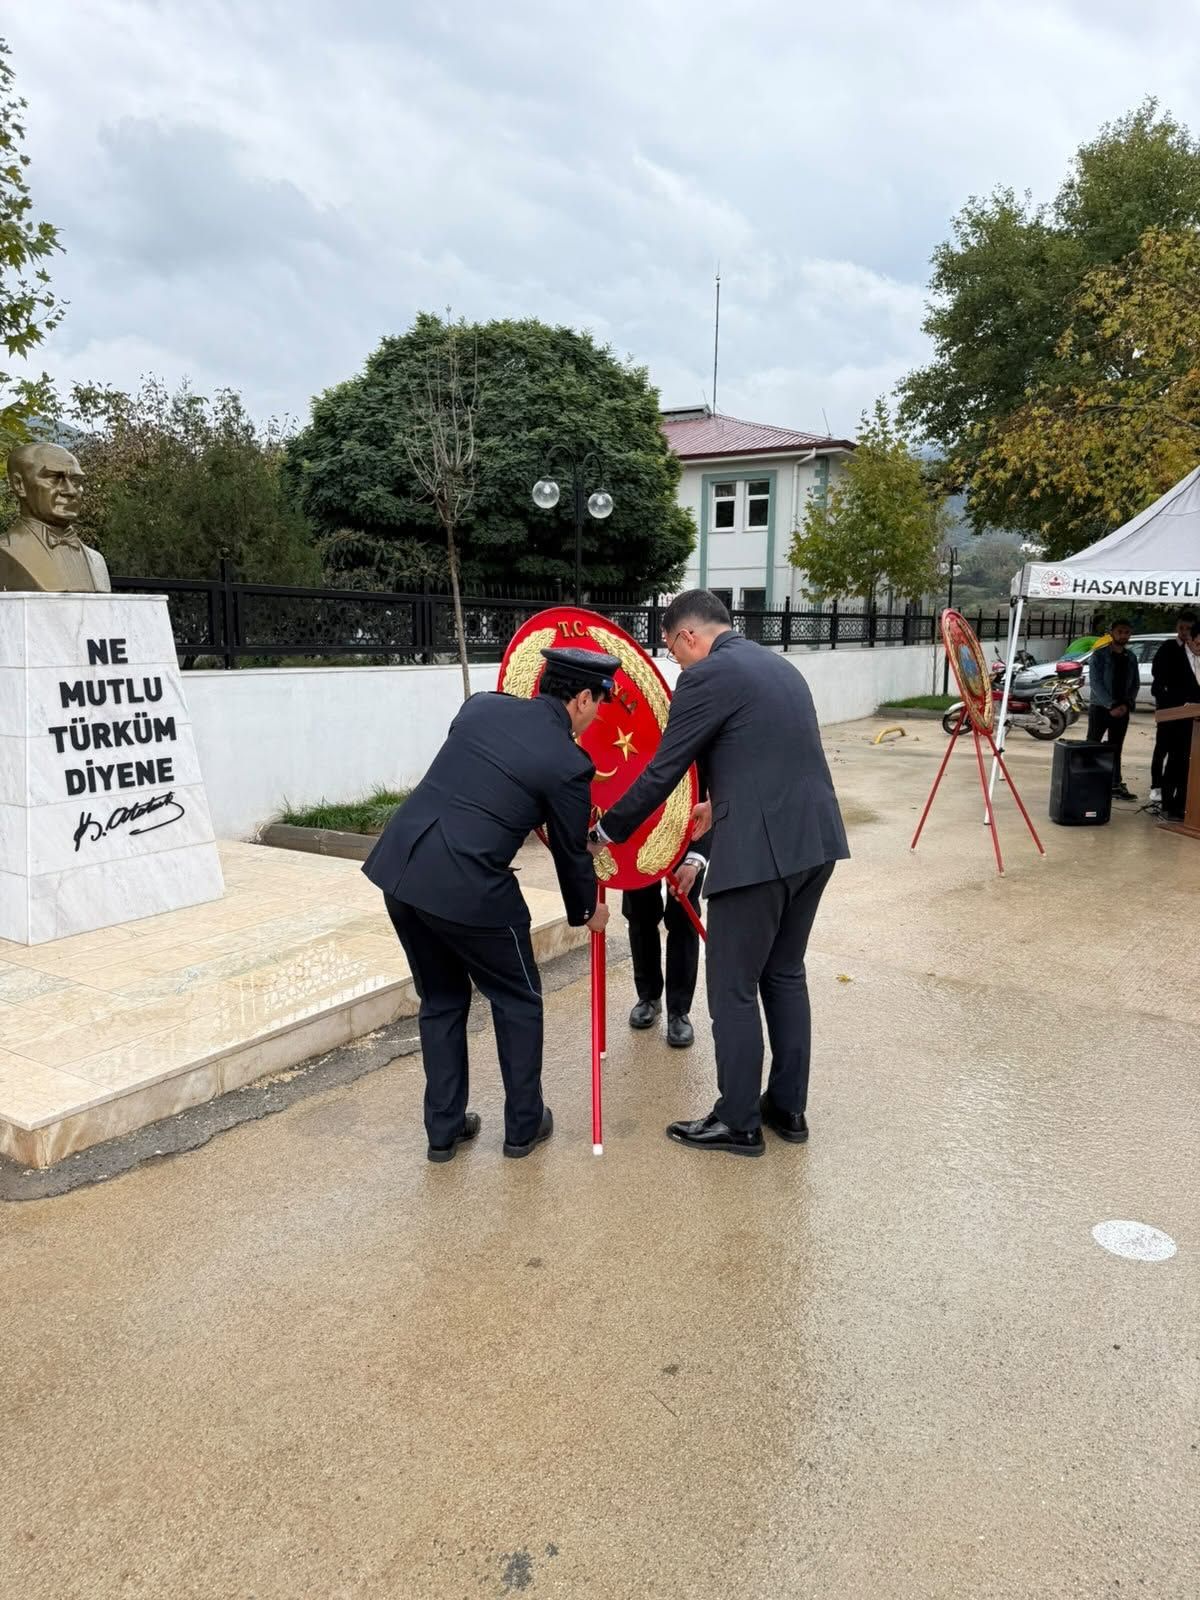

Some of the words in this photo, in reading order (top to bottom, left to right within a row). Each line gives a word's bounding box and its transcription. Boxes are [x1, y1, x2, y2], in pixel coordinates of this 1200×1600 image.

[1072, 578, 1200, 597] HASANBEYLİ
[557, 620, 590, 637] T.C.
[87, 638, 129, 665] NE
[59, 677, 163, 708] MUTLU
[48, 712, 177, 753] TÜRKÜM
[65, 758, 175, 796] DİYENE
